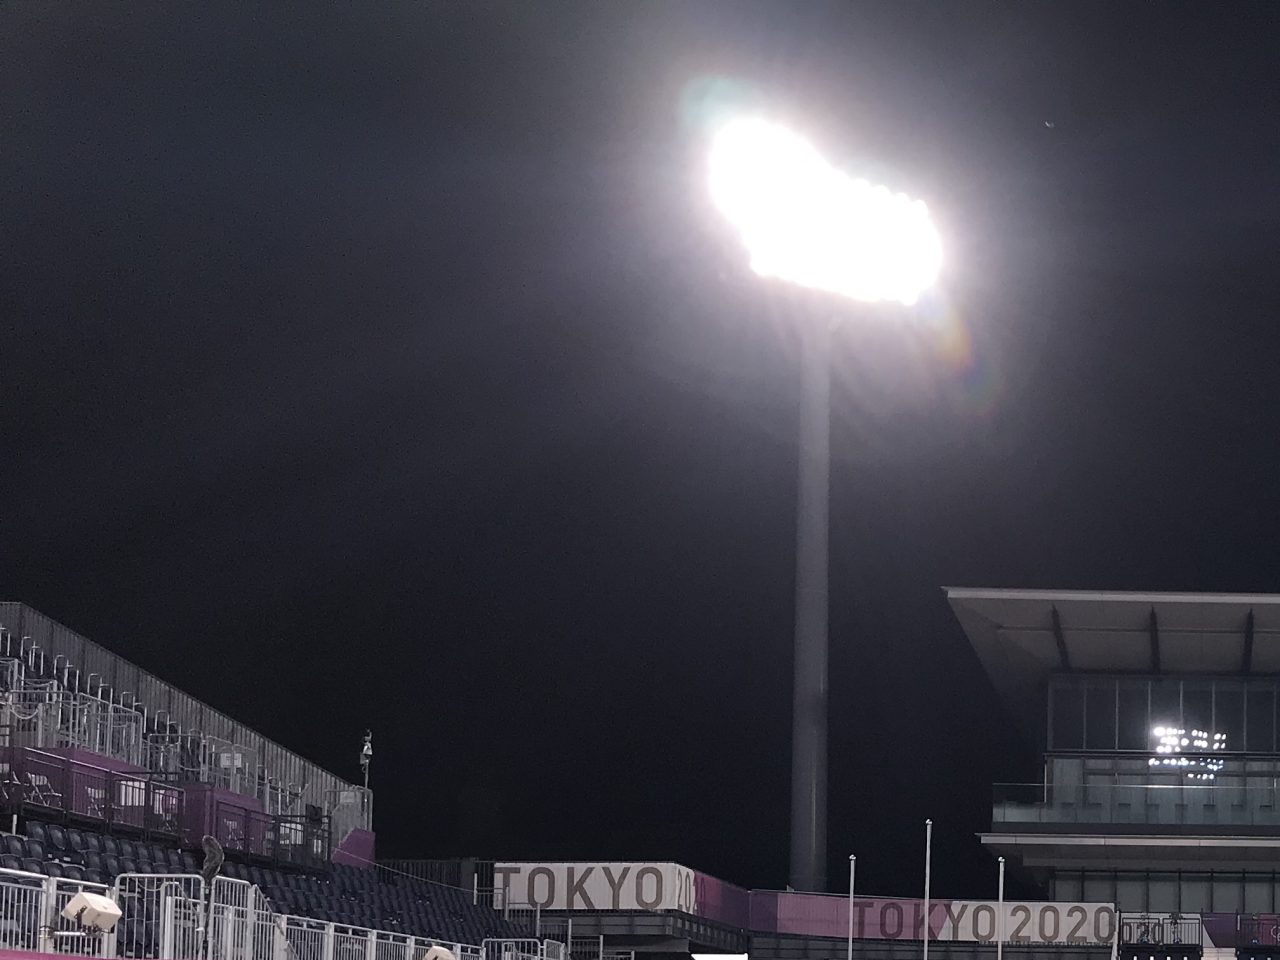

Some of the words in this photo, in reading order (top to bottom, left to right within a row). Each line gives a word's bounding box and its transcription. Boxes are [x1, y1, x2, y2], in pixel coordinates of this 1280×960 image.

[494, 866, 663, 910] TOKYO
[852, 902, 996, 941] TOKYO
[1009, 905, 1116, 943] 2020
